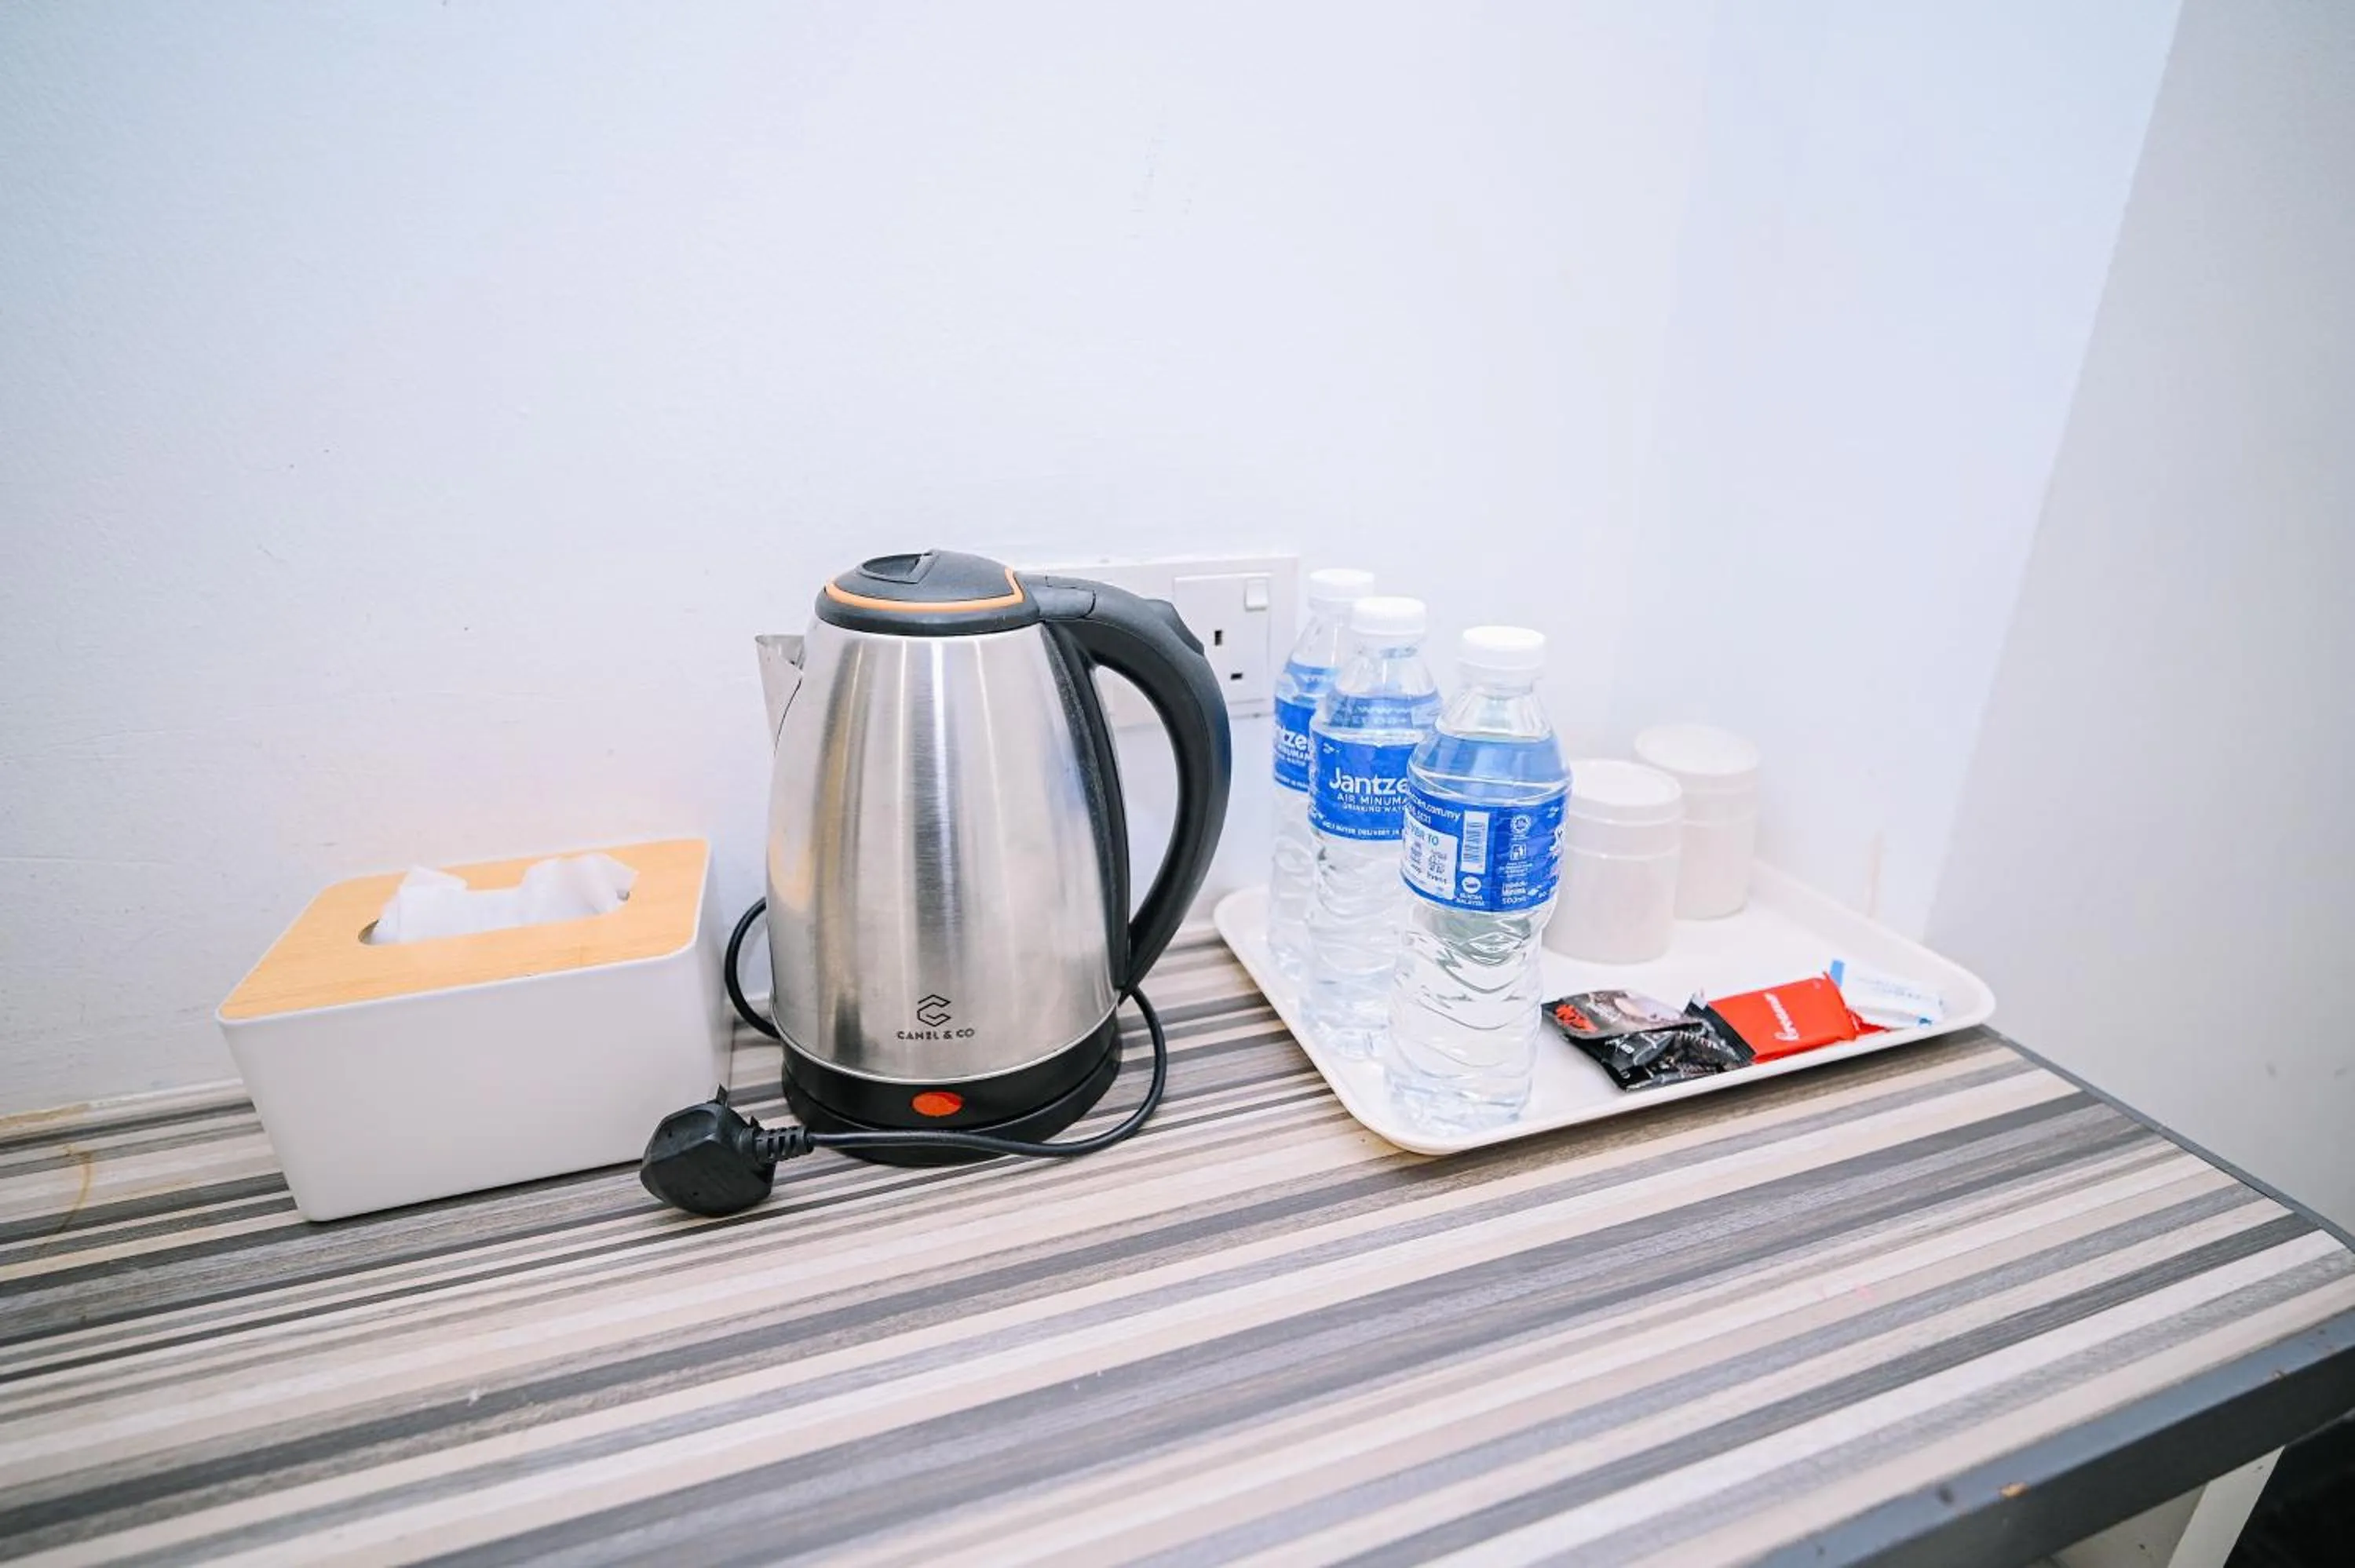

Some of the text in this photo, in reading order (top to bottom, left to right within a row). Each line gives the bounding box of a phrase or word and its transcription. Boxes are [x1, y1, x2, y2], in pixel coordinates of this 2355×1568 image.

[1329, 767, 1408, 796] Jantze
[1337, 793, 1356, 804] AIR
[943, 1030, 954, 1040] &
[955, 1027, 975, 1038] CO
